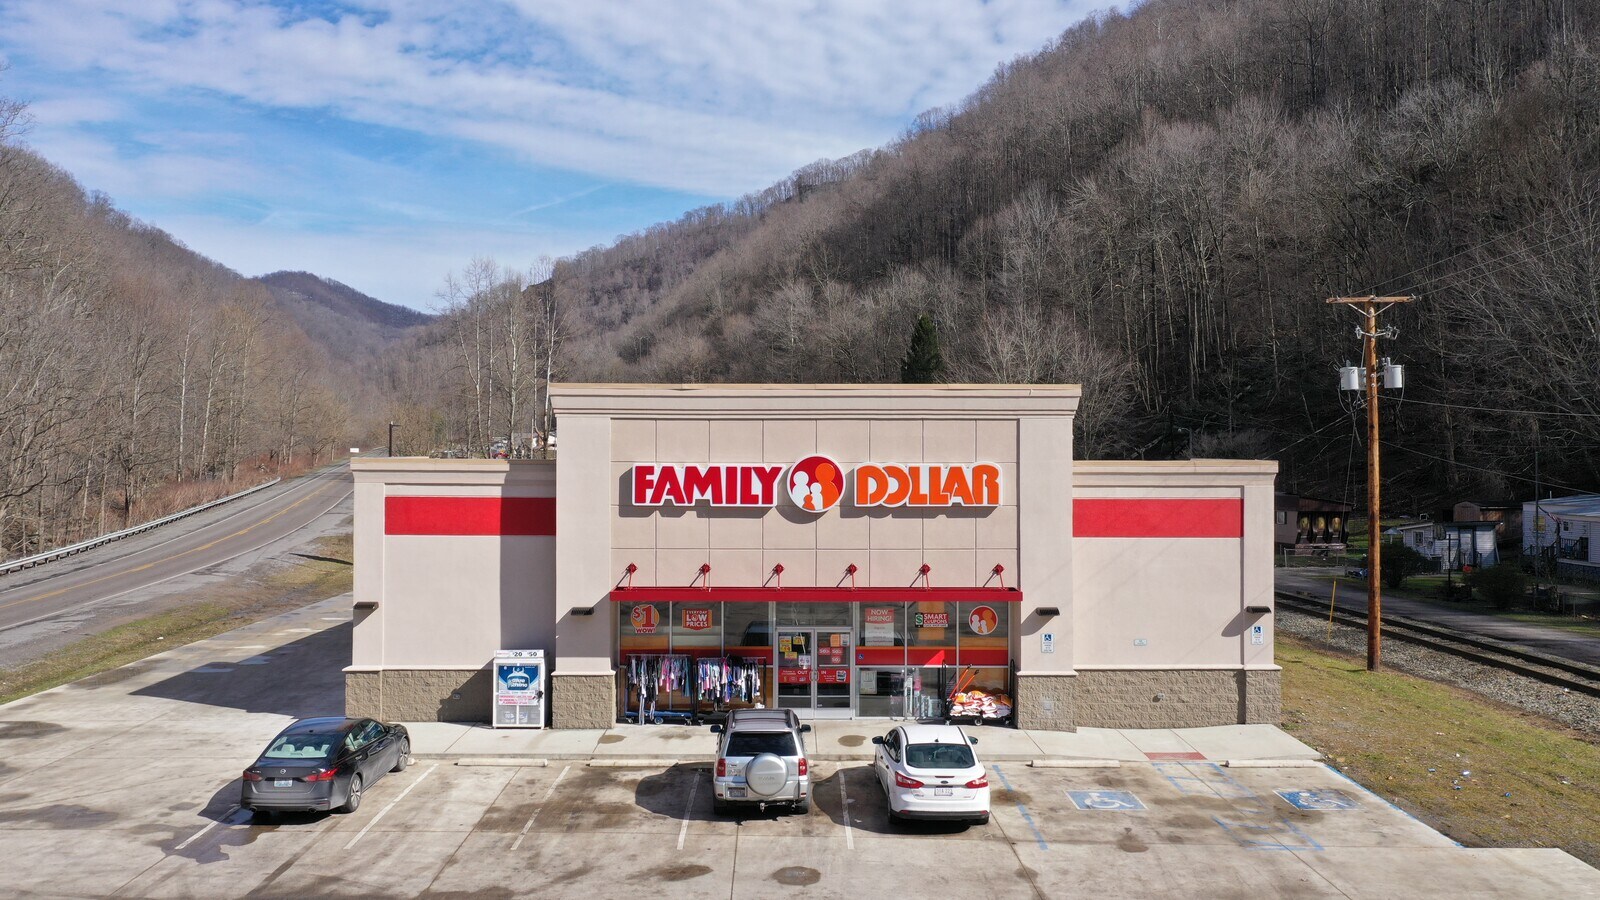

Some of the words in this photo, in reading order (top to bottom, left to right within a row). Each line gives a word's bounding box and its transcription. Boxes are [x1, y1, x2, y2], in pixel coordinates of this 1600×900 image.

[633, 464, 784, 505] FAMILY
[855, 464, 1000, 506] DOLLAR
[633, 605, 655, 627] $1
